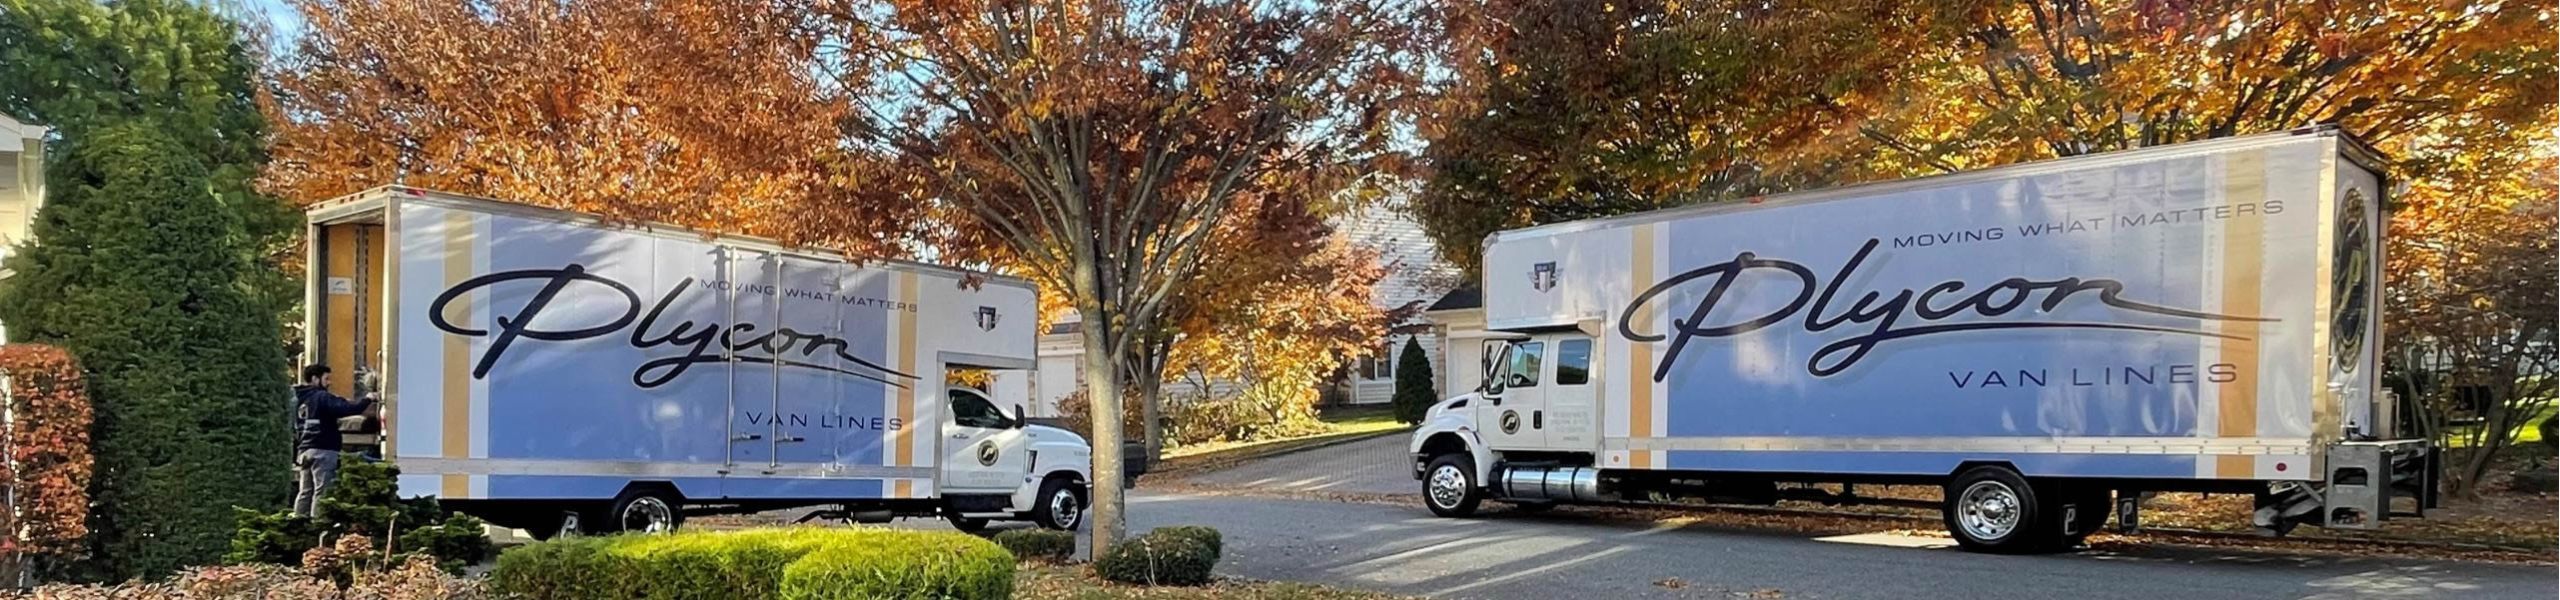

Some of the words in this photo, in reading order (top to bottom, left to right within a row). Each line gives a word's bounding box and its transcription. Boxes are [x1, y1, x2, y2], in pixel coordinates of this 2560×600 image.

[1893, 226, 2005, 249] MOVING
[2018, 216, 2105, 238] WHAT
[2121, 200, 2284, 228] MATTERS
[700, 278, 776, 296] MOVING
[784, 287, 832, 302] WHAT
[841, 295, 918, 313] MATTERS
[1619, 237, 2283, 383] Plycon
[429, 264, 923, 388] Plycon
[1949, 368, 2047, 389] VAN
[2072, 363, 2238, 387] LINES
[746, 411, 808, 427] VAN
[821, 414, 903, 431] LINES
